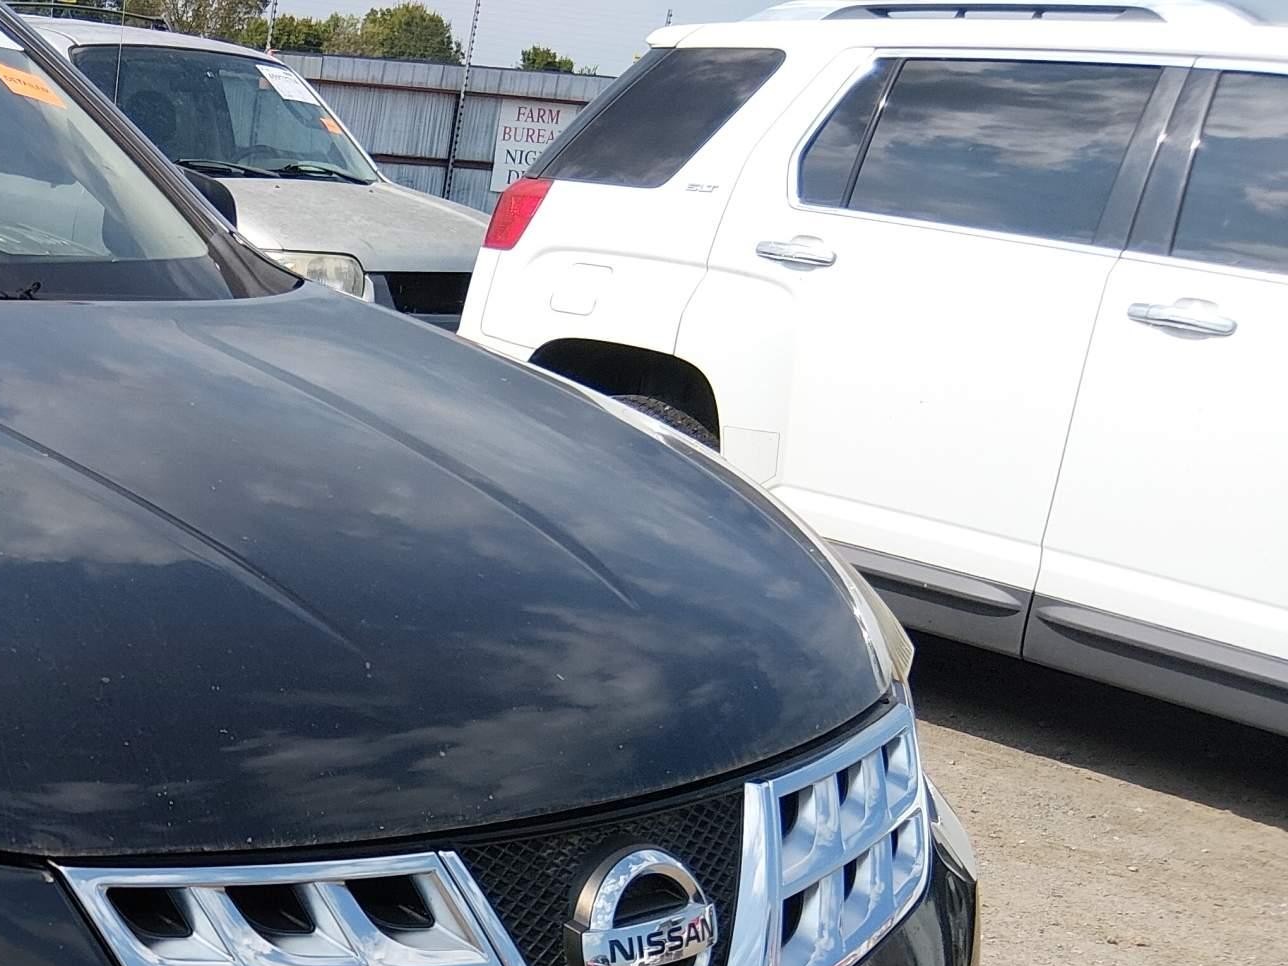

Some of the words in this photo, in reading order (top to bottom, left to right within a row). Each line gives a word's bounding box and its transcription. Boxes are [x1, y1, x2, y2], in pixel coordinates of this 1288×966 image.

[515, 106, 561, 125] FARM
[502, 126, 561, 144] BUREA
[505, 149, 542, 166] NIG
[685, 183, 720, 193] SLT
[608, 915, 713, 964] NISSAN
